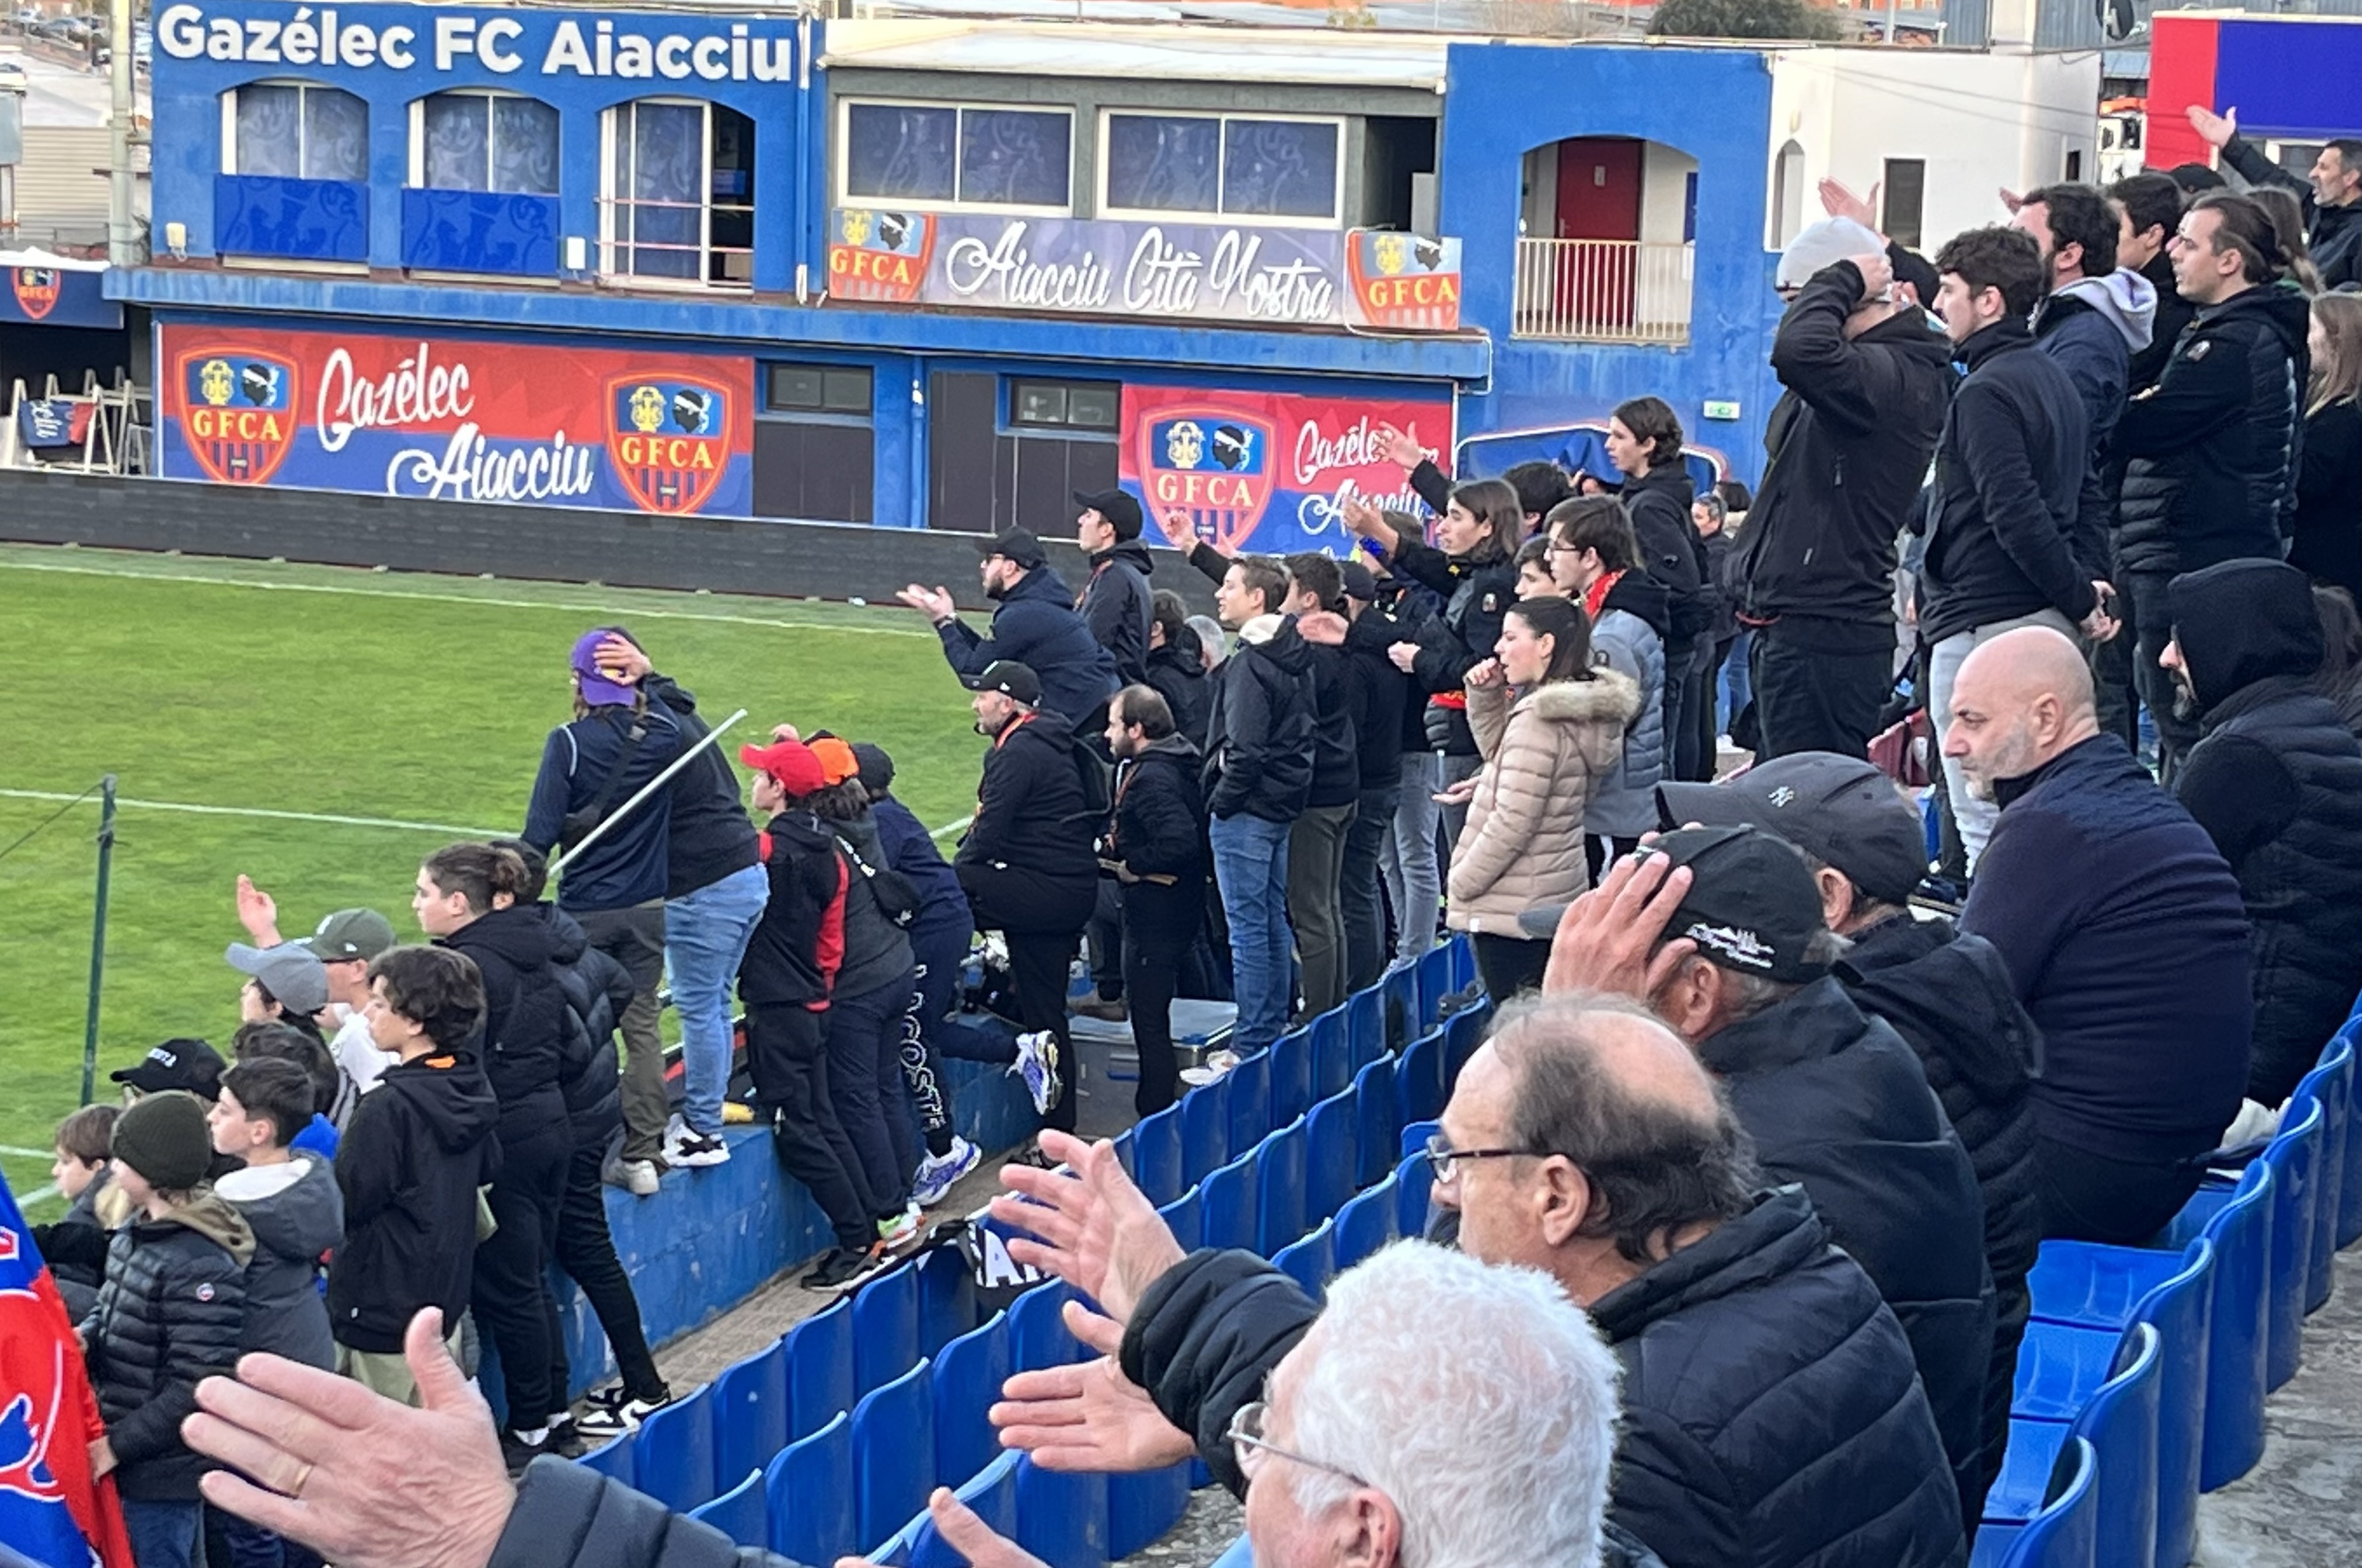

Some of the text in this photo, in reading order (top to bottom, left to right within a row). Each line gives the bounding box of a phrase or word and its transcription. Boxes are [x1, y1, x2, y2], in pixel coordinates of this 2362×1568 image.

[157, 3, 792, 81] Gazélec FC Aiacciu
[829, 247, 911, 286] GFCA
[946, 220, 1333, 321] Aiacciu Cità Nostra
[1369, 278, 1457, 303] GFCA
[317, 342, 474, 452] Gazélec
[193, 409, 282, 441] GFCA
[1294, 416, 1378, 485] Gazéle
[387, 422, 594, 501] Aiacciu
[622, 437, 714, 469] GFCA
[1157, 473, 1254, 508] GFCA
